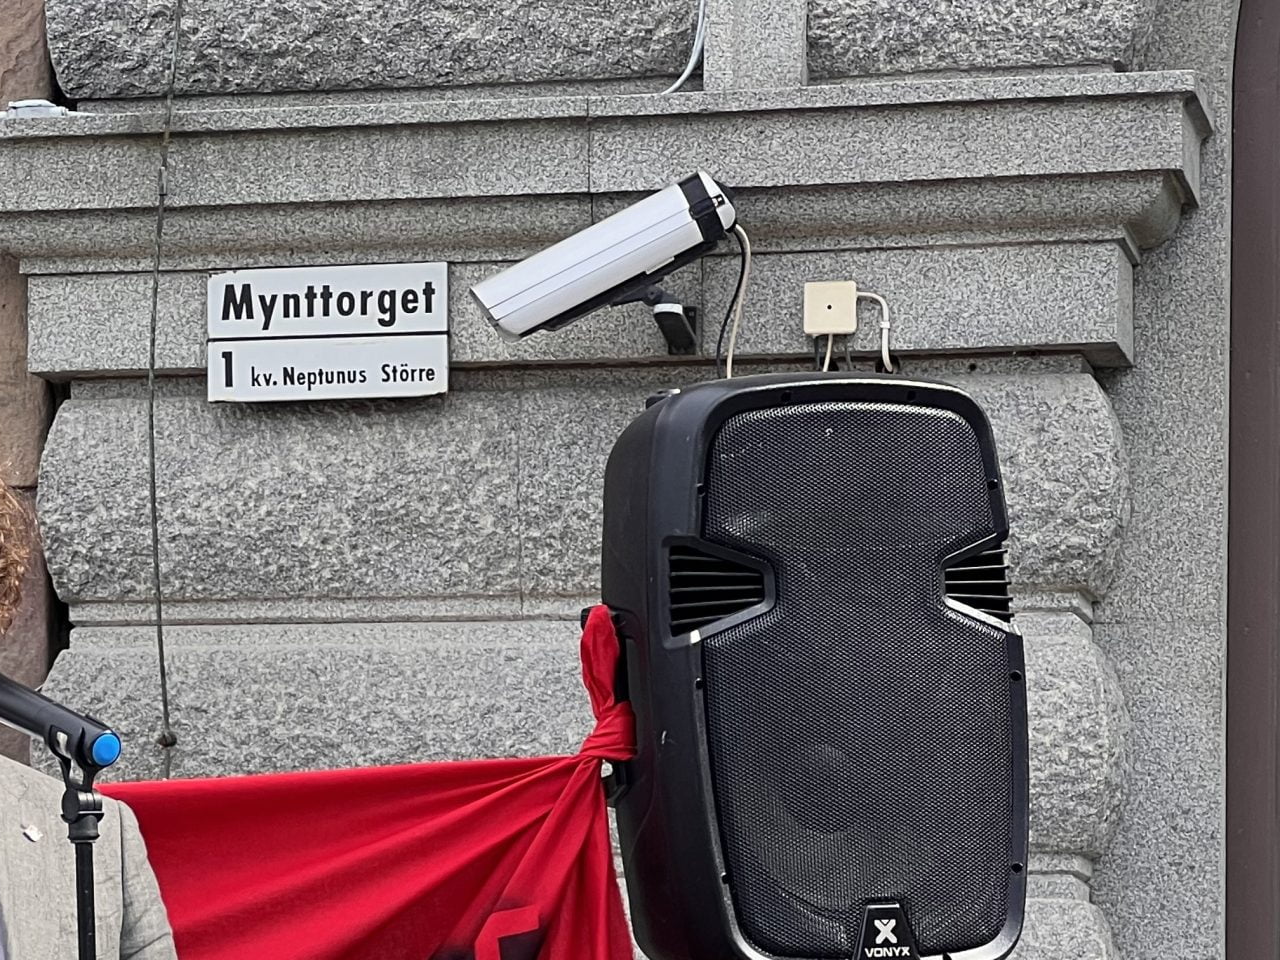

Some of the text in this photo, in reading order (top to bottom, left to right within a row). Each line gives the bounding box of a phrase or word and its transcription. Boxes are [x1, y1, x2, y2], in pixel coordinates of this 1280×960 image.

[221, 281, 436, 331] Mynttorget
[221, 351, 435, 391] 1 kv. Neptunus Större
[864, 946, 911, 958] VONYX
